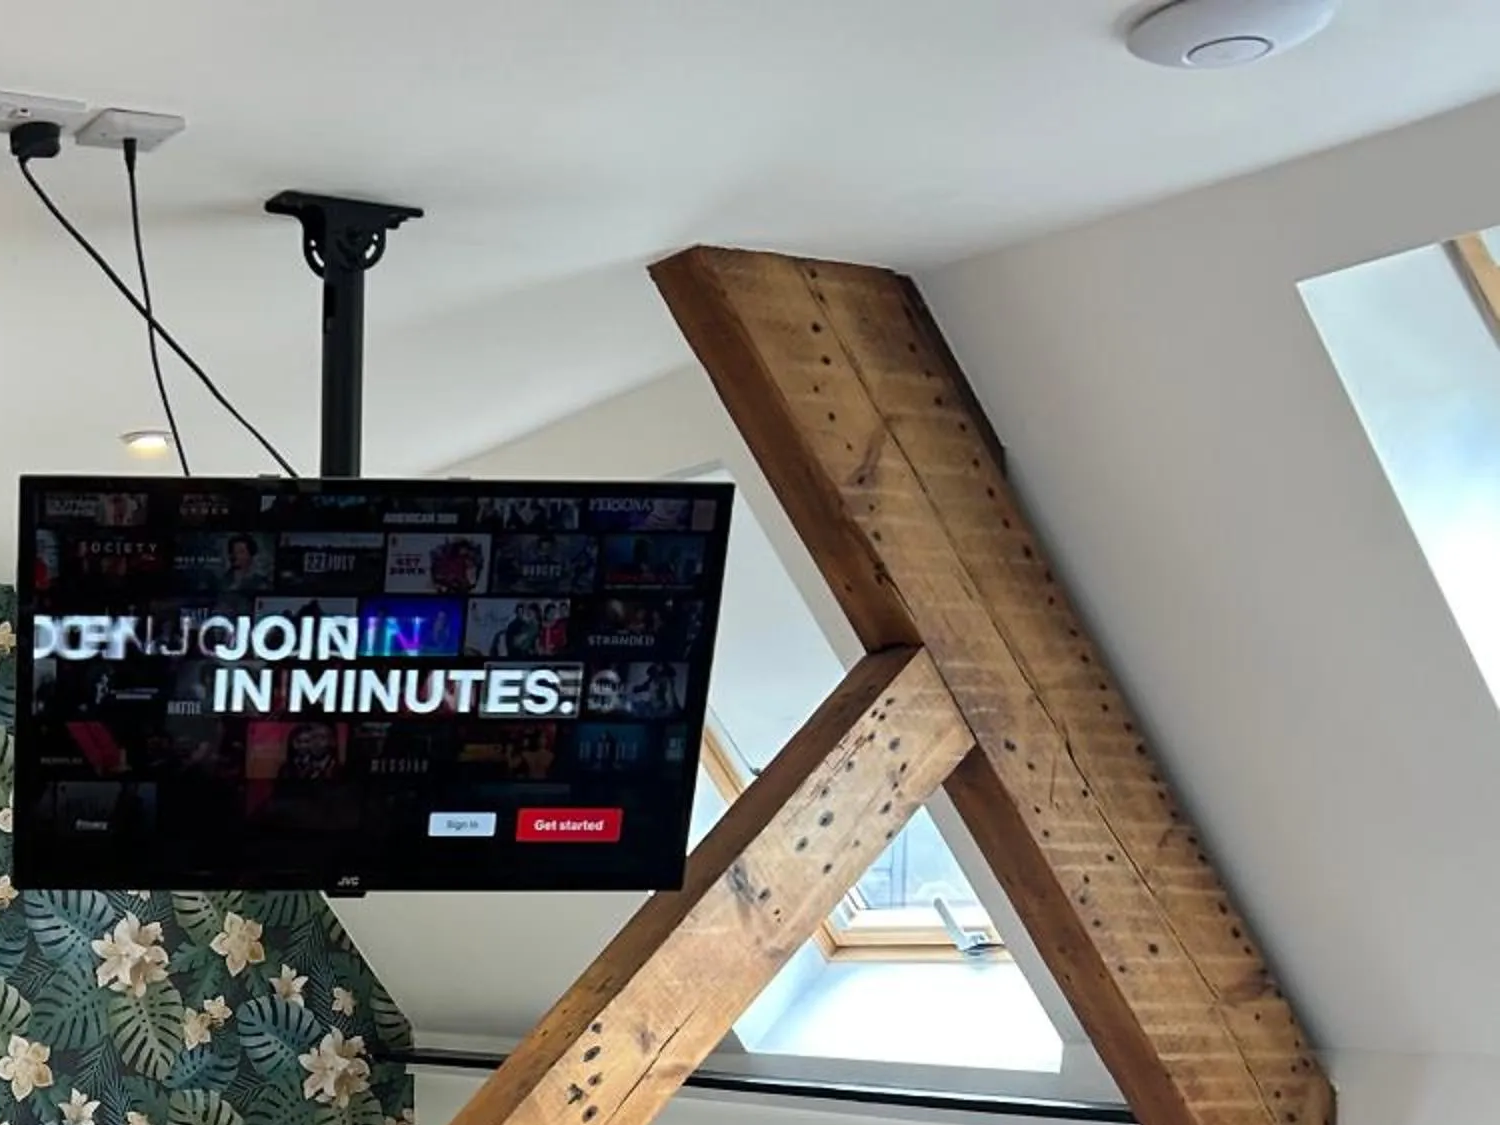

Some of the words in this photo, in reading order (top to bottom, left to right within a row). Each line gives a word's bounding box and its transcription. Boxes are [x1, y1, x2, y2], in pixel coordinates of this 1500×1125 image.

[214, 615, 359, 660] JOIN
[213, 669, 272, 713] IN
[288, 669, 575, 714] MINUTES.
[533, 818, 557, 832] Get
[559, 818, 604, 832] started
[337, 875, 360, 887] JVC
